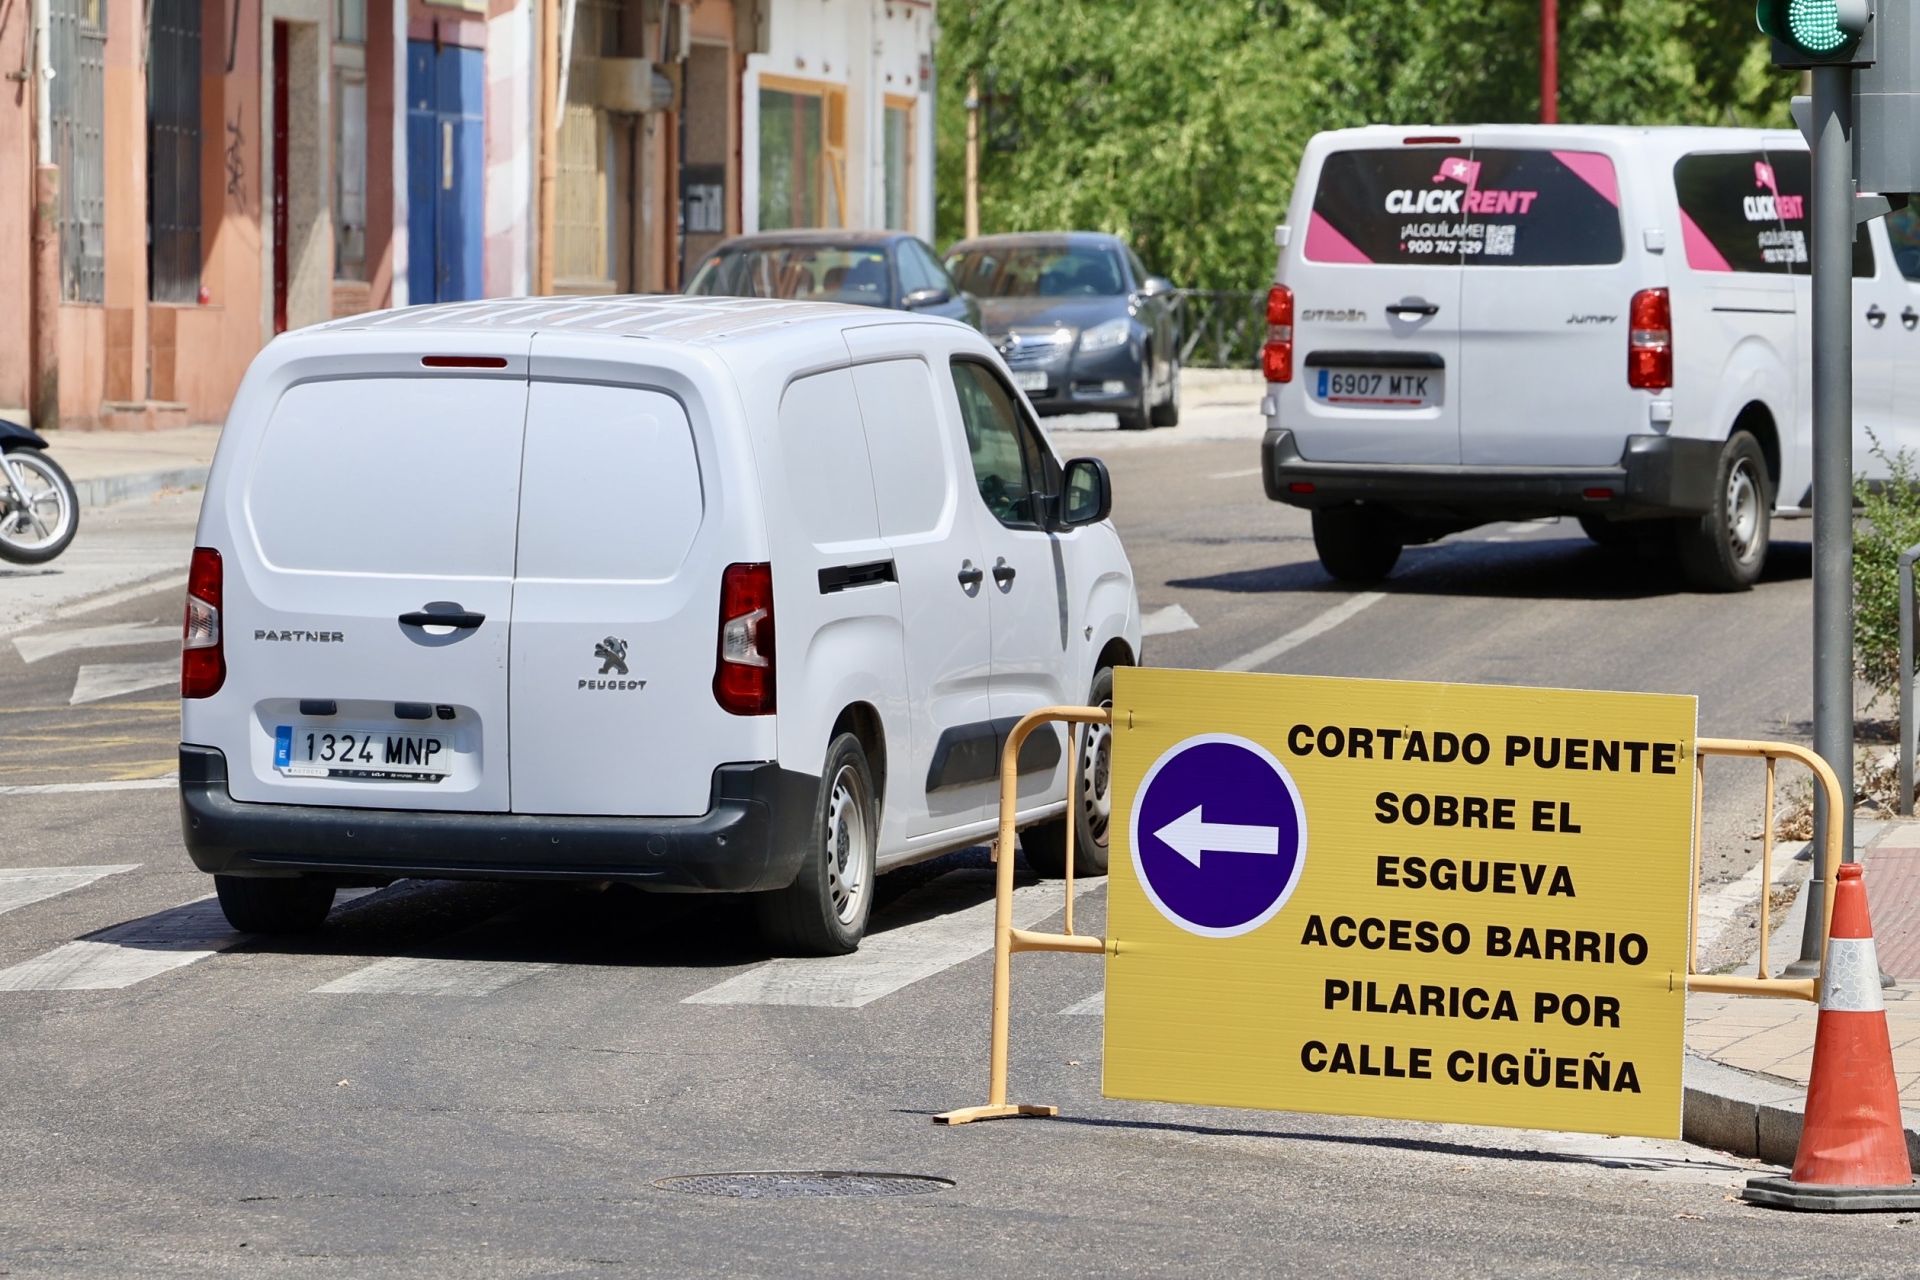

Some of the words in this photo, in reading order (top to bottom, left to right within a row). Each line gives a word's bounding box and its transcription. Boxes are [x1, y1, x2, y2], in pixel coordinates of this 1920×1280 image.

[1407, 240, 1433, 253] 900
[1435, 241, 1457, 253] 747
[1332, 374, 1382, 394] 6907
[1389, 376, 1428, 396] MTK
[254, 630, 344, 642] PARTNER
[578, 680, 647, 691] PEUGEOT
[306, 733, 373, 763] 1324
[385, 736, 441, 766] MNP
[1287, 724, 1491, 764] CORTADO
[1505, 735, 1676, 775] PUENTE
[1374, 792, 1516, 830] SOBRE
[1531, 800, 1582, 833] EL
[1376, 855, 1576, 897] ESGUEVA
[1300, 914, 1471, 955] ACCESO
[1486, 925, 1649, 966] BARRIO
[1324, 978, 1519, 1022] PILARICA
[1534, 991, 1621, 1028] POR
[1300, 1040, 1432, 1080] CALLE
[1446, 1048, 1642, 1094] CIGÜEÑA
